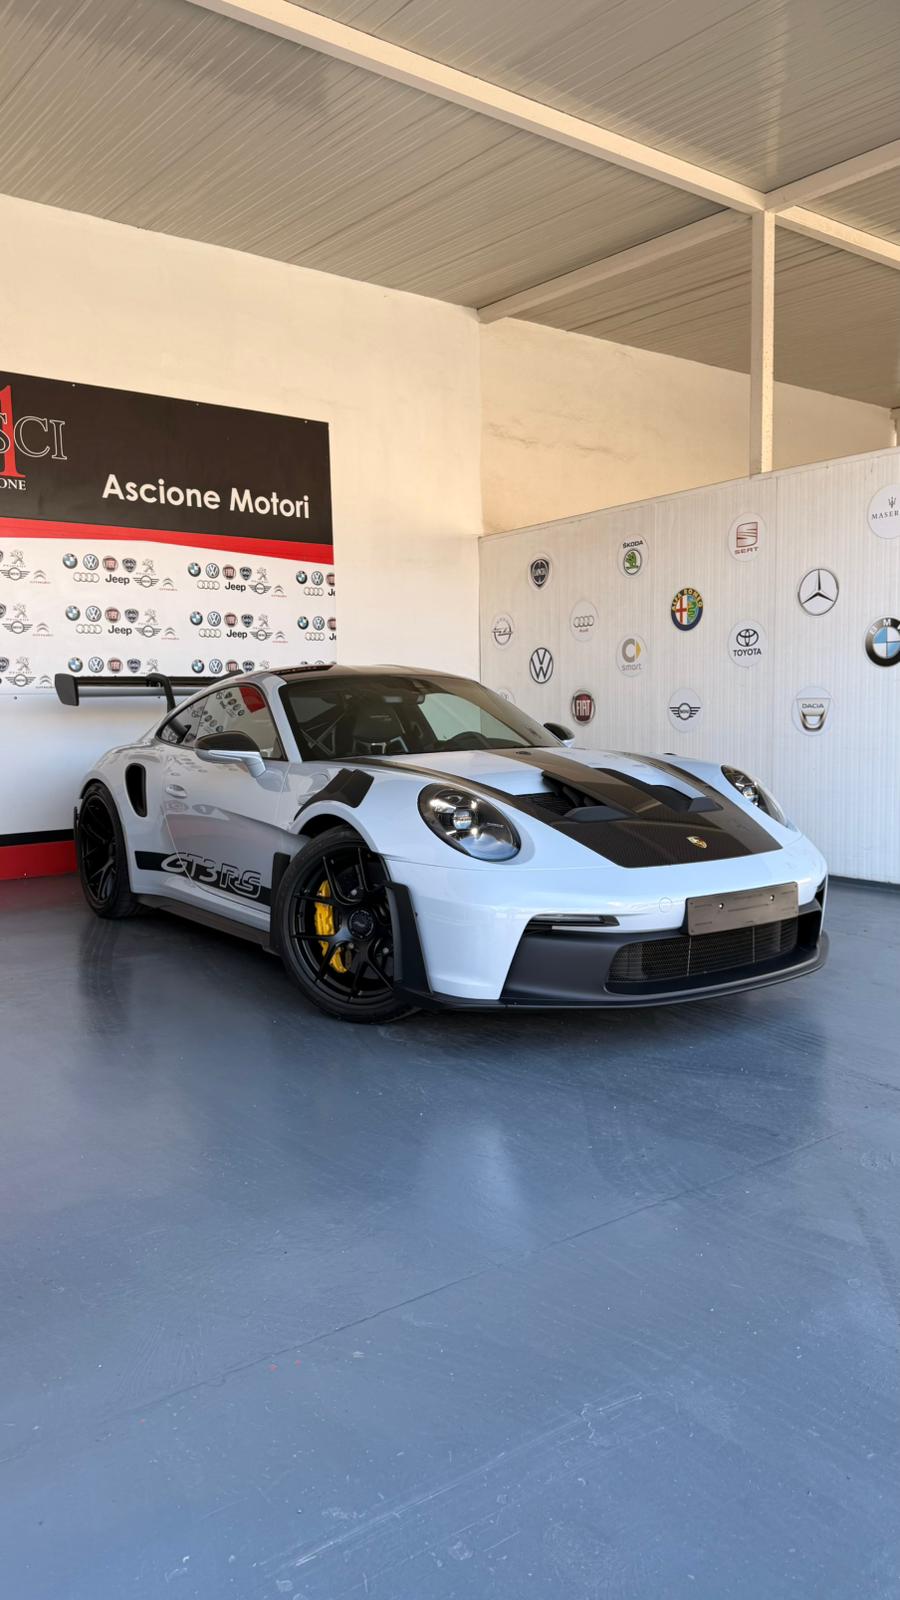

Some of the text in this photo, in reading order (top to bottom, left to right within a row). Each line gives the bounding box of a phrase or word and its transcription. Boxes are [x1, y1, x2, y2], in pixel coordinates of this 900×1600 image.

[102, 473, 310, 519] Ascione Motori
[735, 547, 759, 555] SEAT
[105, 574, 131, 586] Jeep
[225, 582, 246, 592] Jeep
[108, 625, 133, 636] Jeep
[226, 629, 248, 640] Jeep
[733, 648, 762, 657] TOYOTA
[621, 663, 642, 671] smart
[575, 699, 591, 716] FIAT
